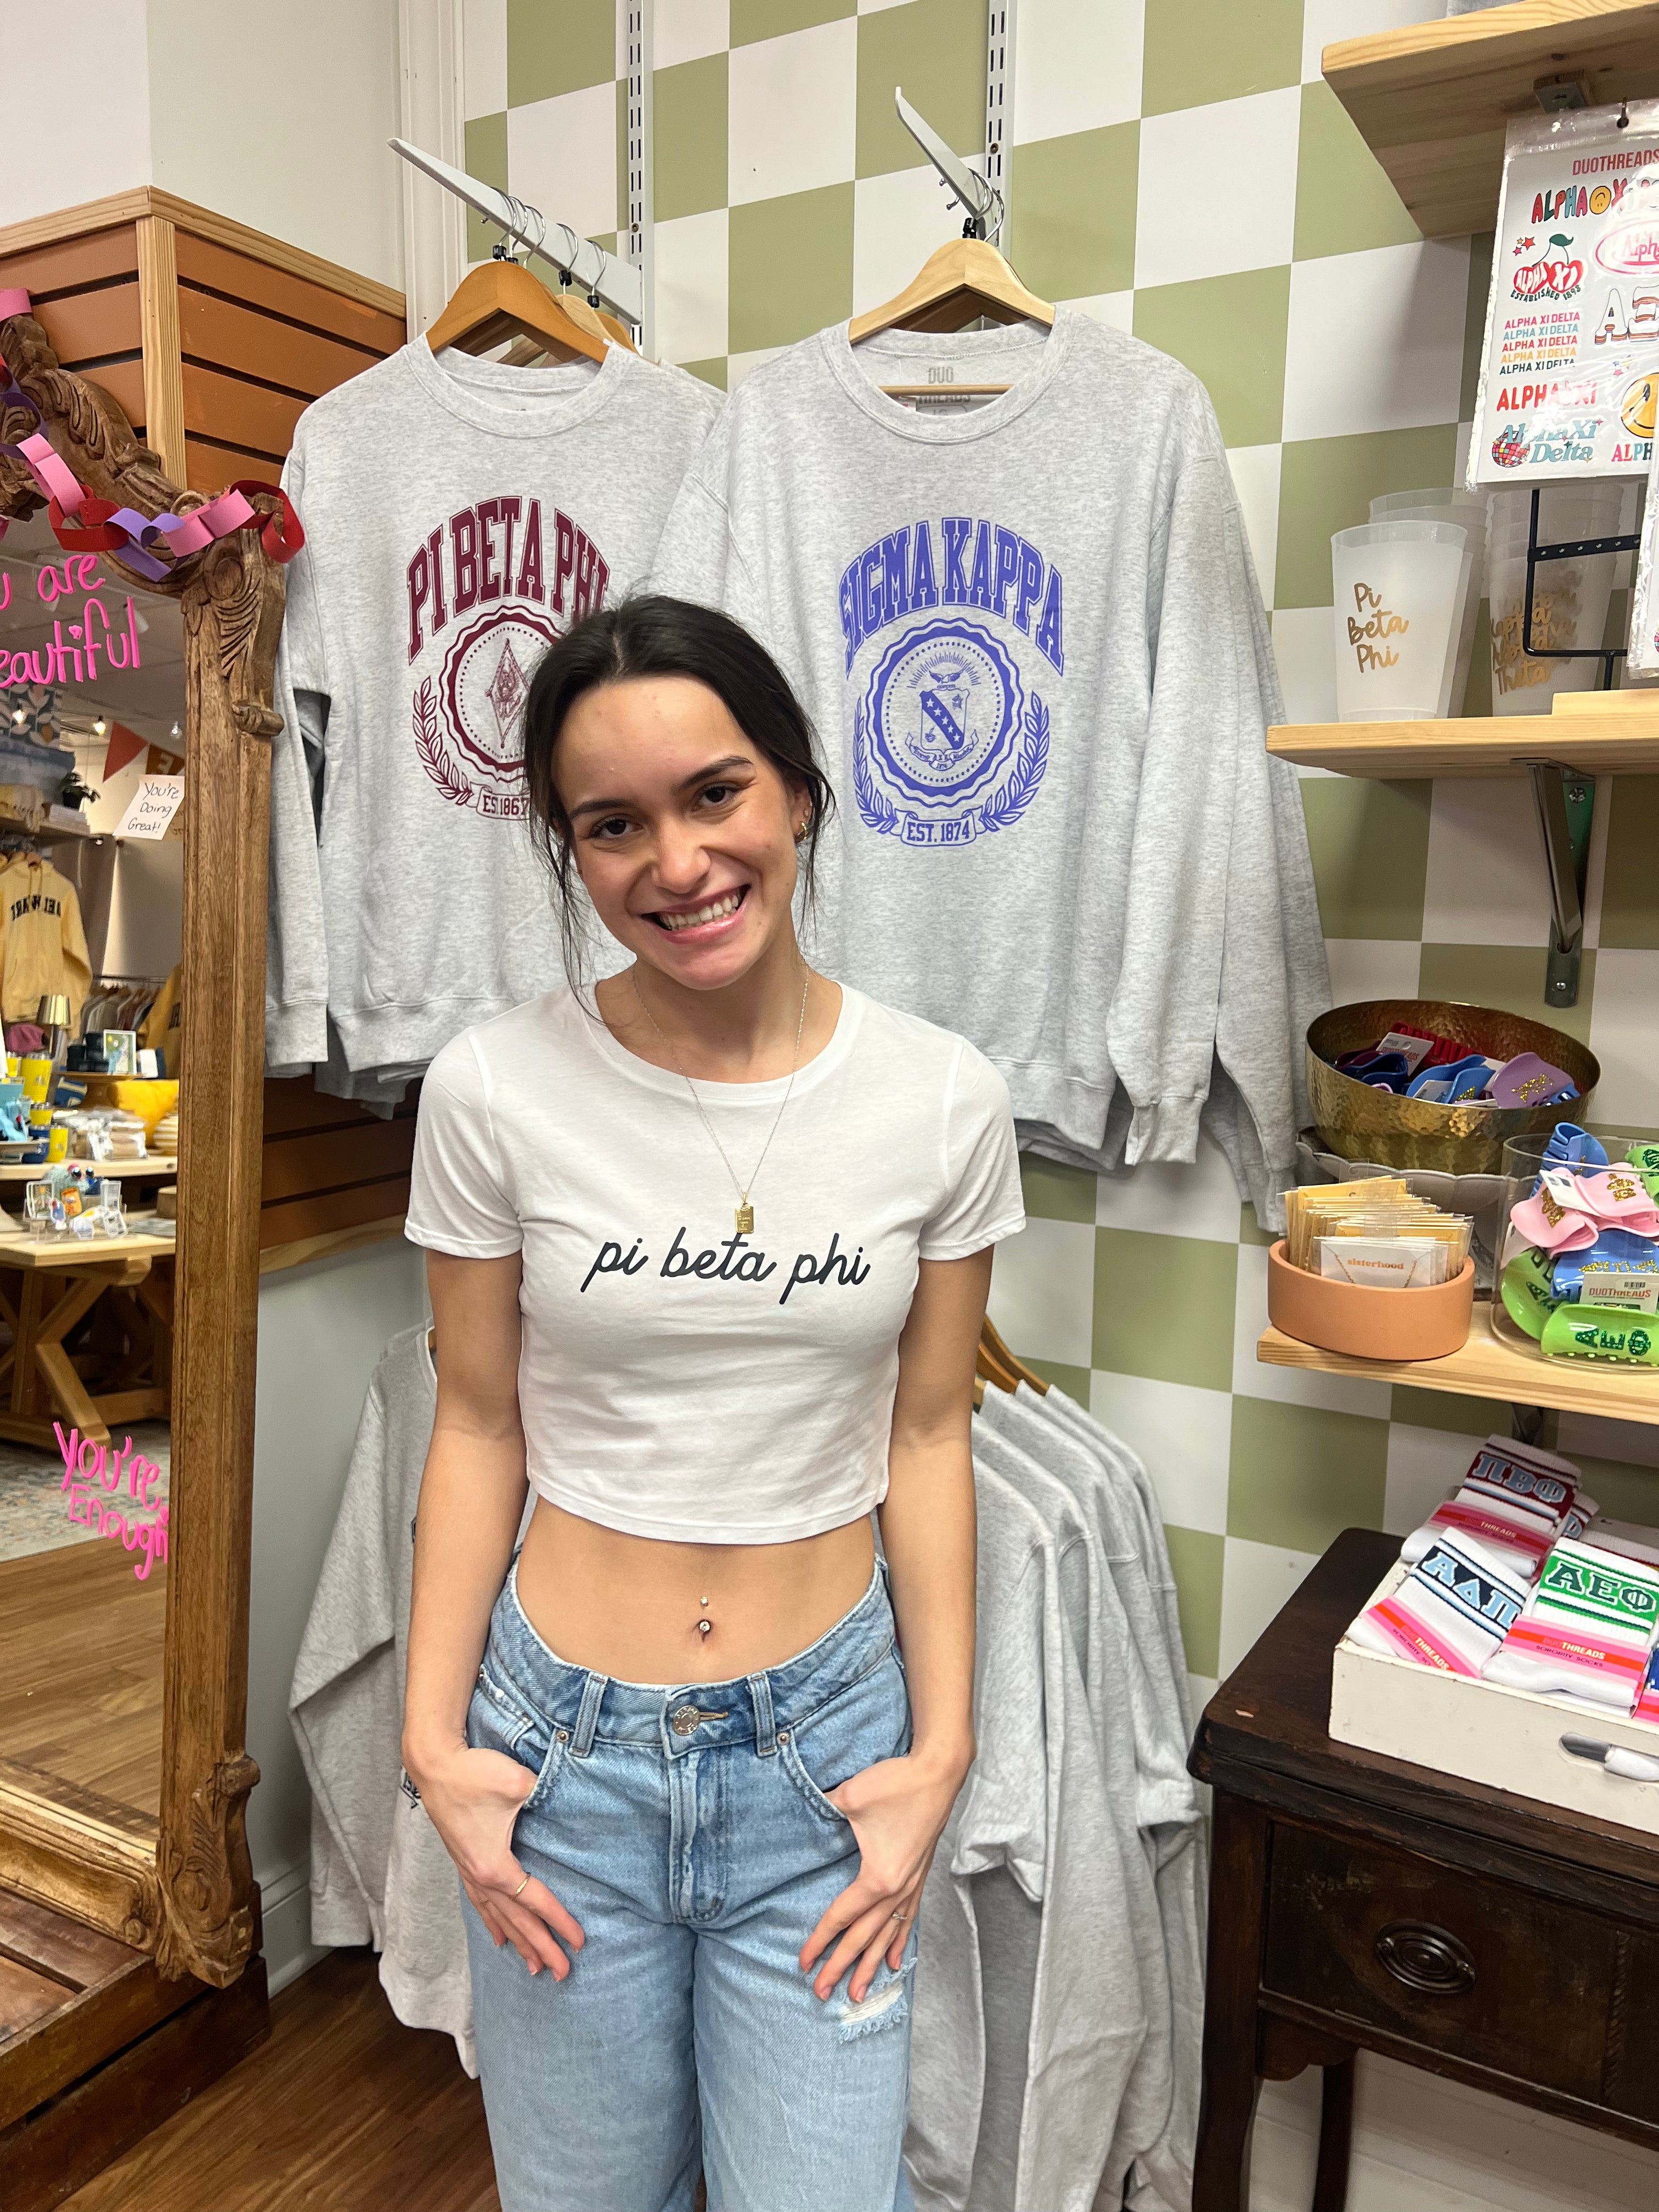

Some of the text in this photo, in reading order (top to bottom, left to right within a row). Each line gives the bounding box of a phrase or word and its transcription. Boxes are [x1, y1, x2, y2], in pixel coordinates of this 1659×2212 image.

[1572, 149, 1659, 176] DUOTHREADS
[1531, 185, 1588, 224] ALPHA
[1515, 262, 1578, 293] ALPHA XI
[1510, 284, 1581, 302] ESTABLISHED 1893
[1504, 312, 1580, 329] ALPHA XI DELTA
[1503, 323, 1579, 341] ALPHA XI DELTA
[1502, 335, 1577, 352] ALPHA XI DELTA
[1500, 347, 1576, 363] ALPHA XI DELTA
[928, 367, 953, 384] DUO
[1499, 363, 1532, 375] ALPHA
[1535, 361, 1545, 371] XI
[1497, 423, 1570, 445] Alha
[1529, 441, 1593, 463] Delta
[37, 555, 106, 602] are
[407, 496, 610, 666] PI BETA PHI
[839, 517, 1064, 680] SIGMA KAPPA
[1354, 583, 1382, 612] Pi
[1347, 609, 1409, 646] Beta
[1357, 644, 1399, 673] Phi
[140, 802, 172, 819] Doing
[128, 817, 161, 833] Great!
[906, 820, 970, 843] EST. 1874
[580, 1226, 871, 1305] pi beta phi
[1347, 1259, 1404, 1270] sisterhood
[1589, 1288, 1651, 1298] DUOTHREADS
[69, 1484, 168, 1581] Enough
[1577, 1657, 1603, 1667] SOCKS
